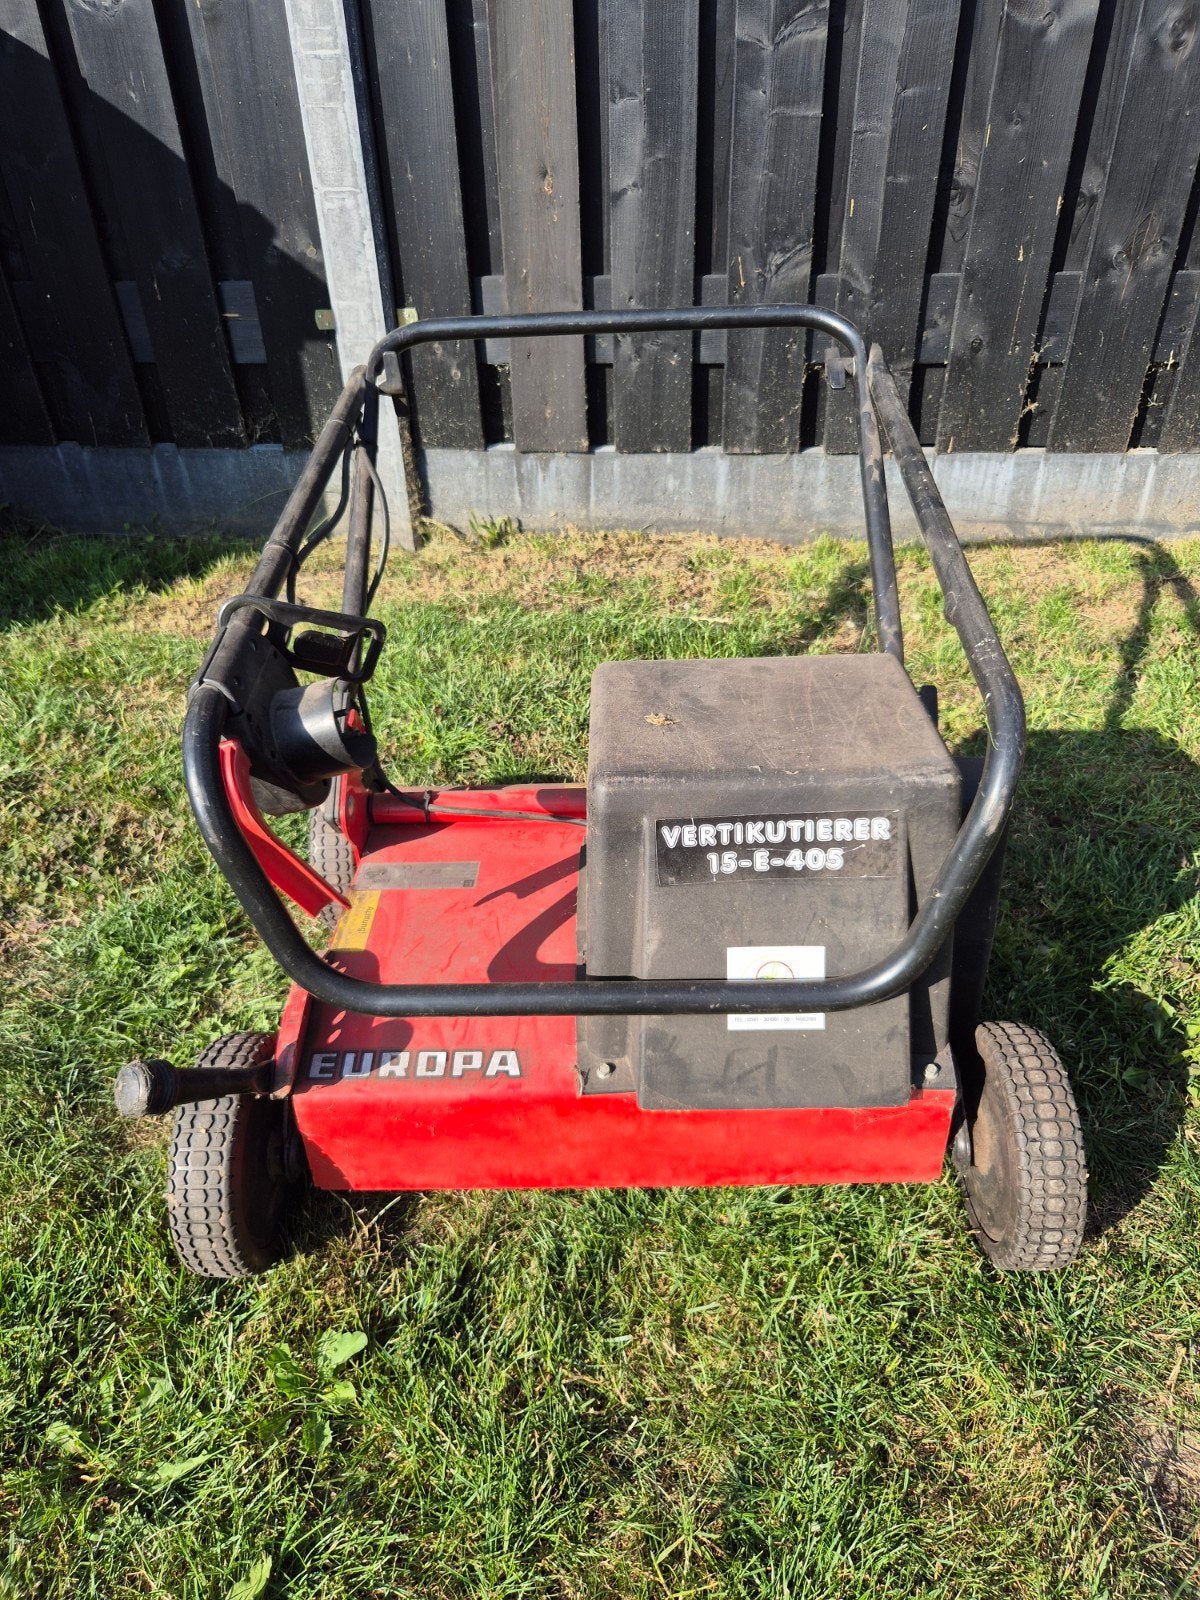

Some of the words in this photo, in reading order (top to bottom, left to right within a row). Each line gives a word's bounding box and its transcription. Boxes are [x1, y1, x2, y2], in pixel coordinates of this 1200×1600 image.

[661, 817, 891, 848] VERTIKUTIERER
[707, 848, 844, 874] 15-E-405
[308, 1050, 522, 1078] EUROPA
